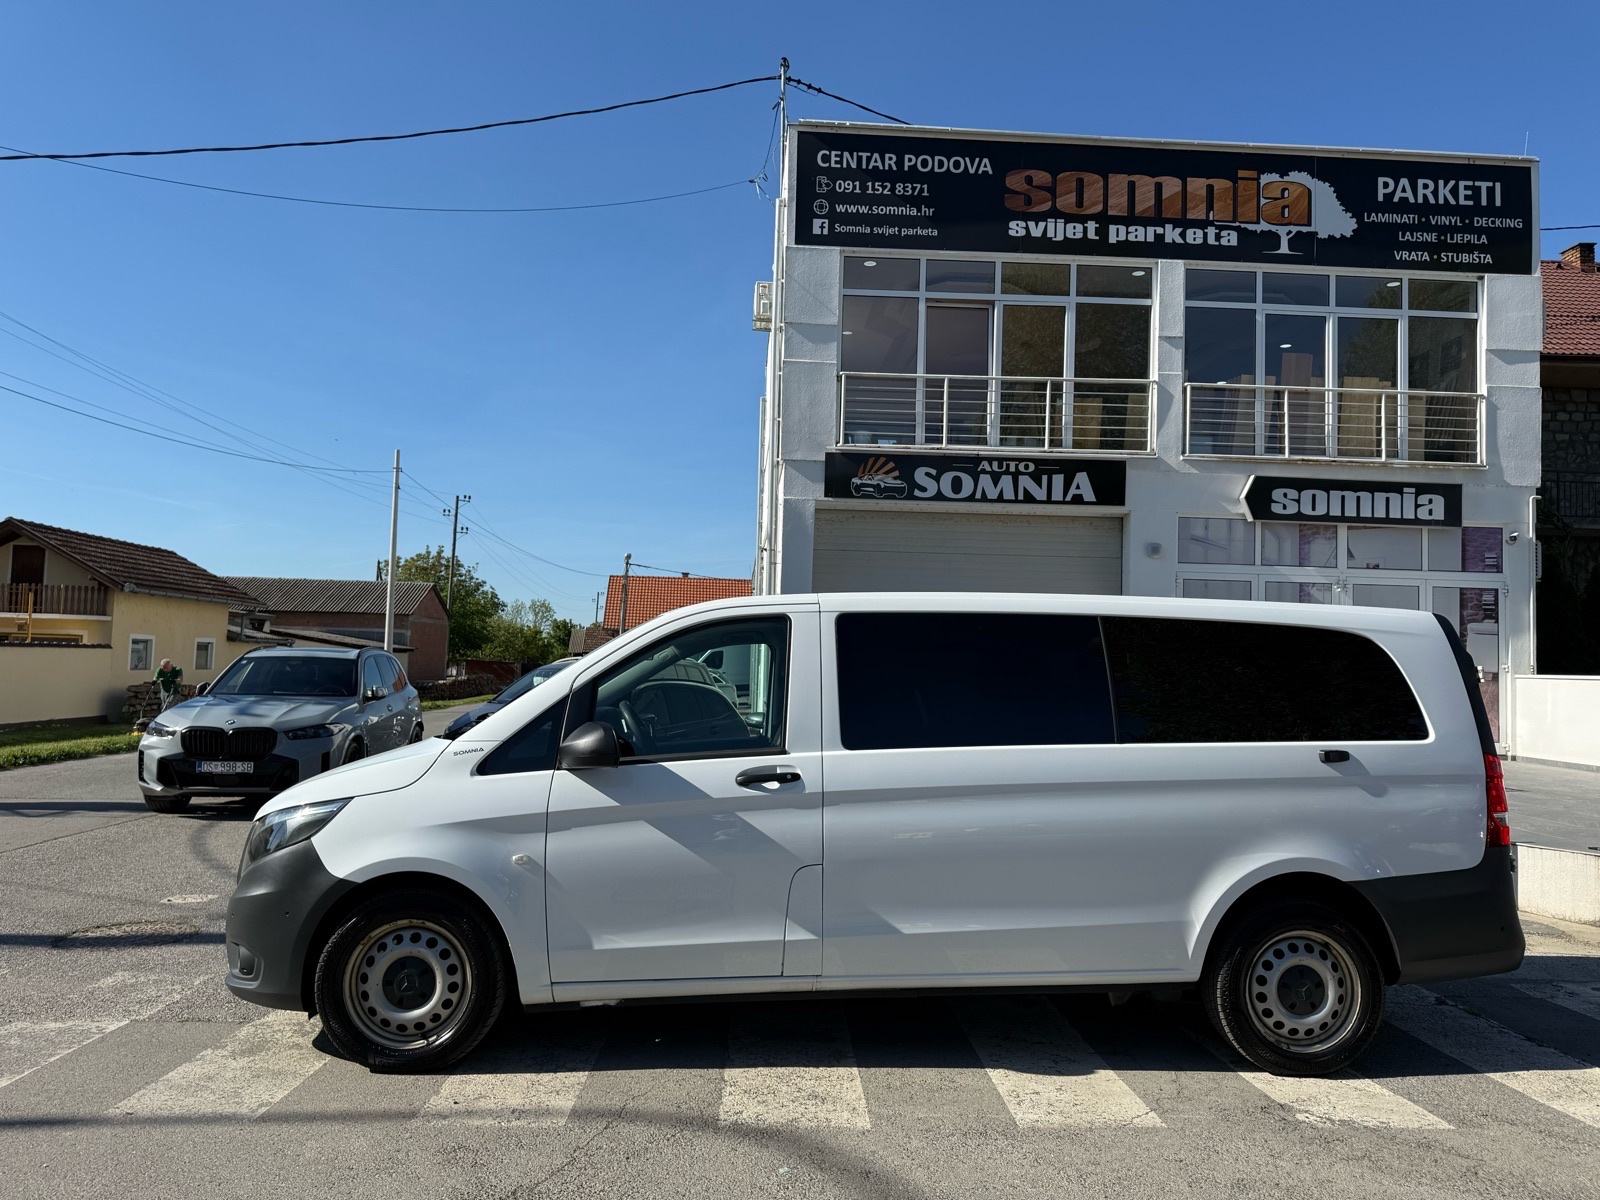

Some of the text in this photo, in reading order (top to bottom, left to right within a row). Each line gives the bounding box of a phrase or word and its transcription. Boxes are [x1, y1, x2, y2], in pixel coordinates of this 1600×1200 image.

[816, 150, 993, 175] CENTAR PODOVA
[835, 180, 929, 196] 091 152 8371
[1377, 176, 1502, 207] PARKETI
[1004, 169, 1312, 226] somnia
[835, 204, 935, 217] www.somnia.hr
[1364, 212, 1523, 229] LAMINATI VINYL DECKING
[834, 223, 871, 234] Somnia
[873, 225, 899, 236] svijet
[901, 226, 938, 237] parketa
[1008, 219, 1238, 247] svijet parketa
[1399, 231, 1488, 245] LAJSNE LJEPILA
[1394, 250, 1493, 264] VRATA STUBIŠTA
[977, 460, 1035, 473] AUTO
[913, 466, 1097, 502] SOMNIA
[1270, 487, 1445, 521] somnia
[453, 747, 484, 757] SOMNIA
